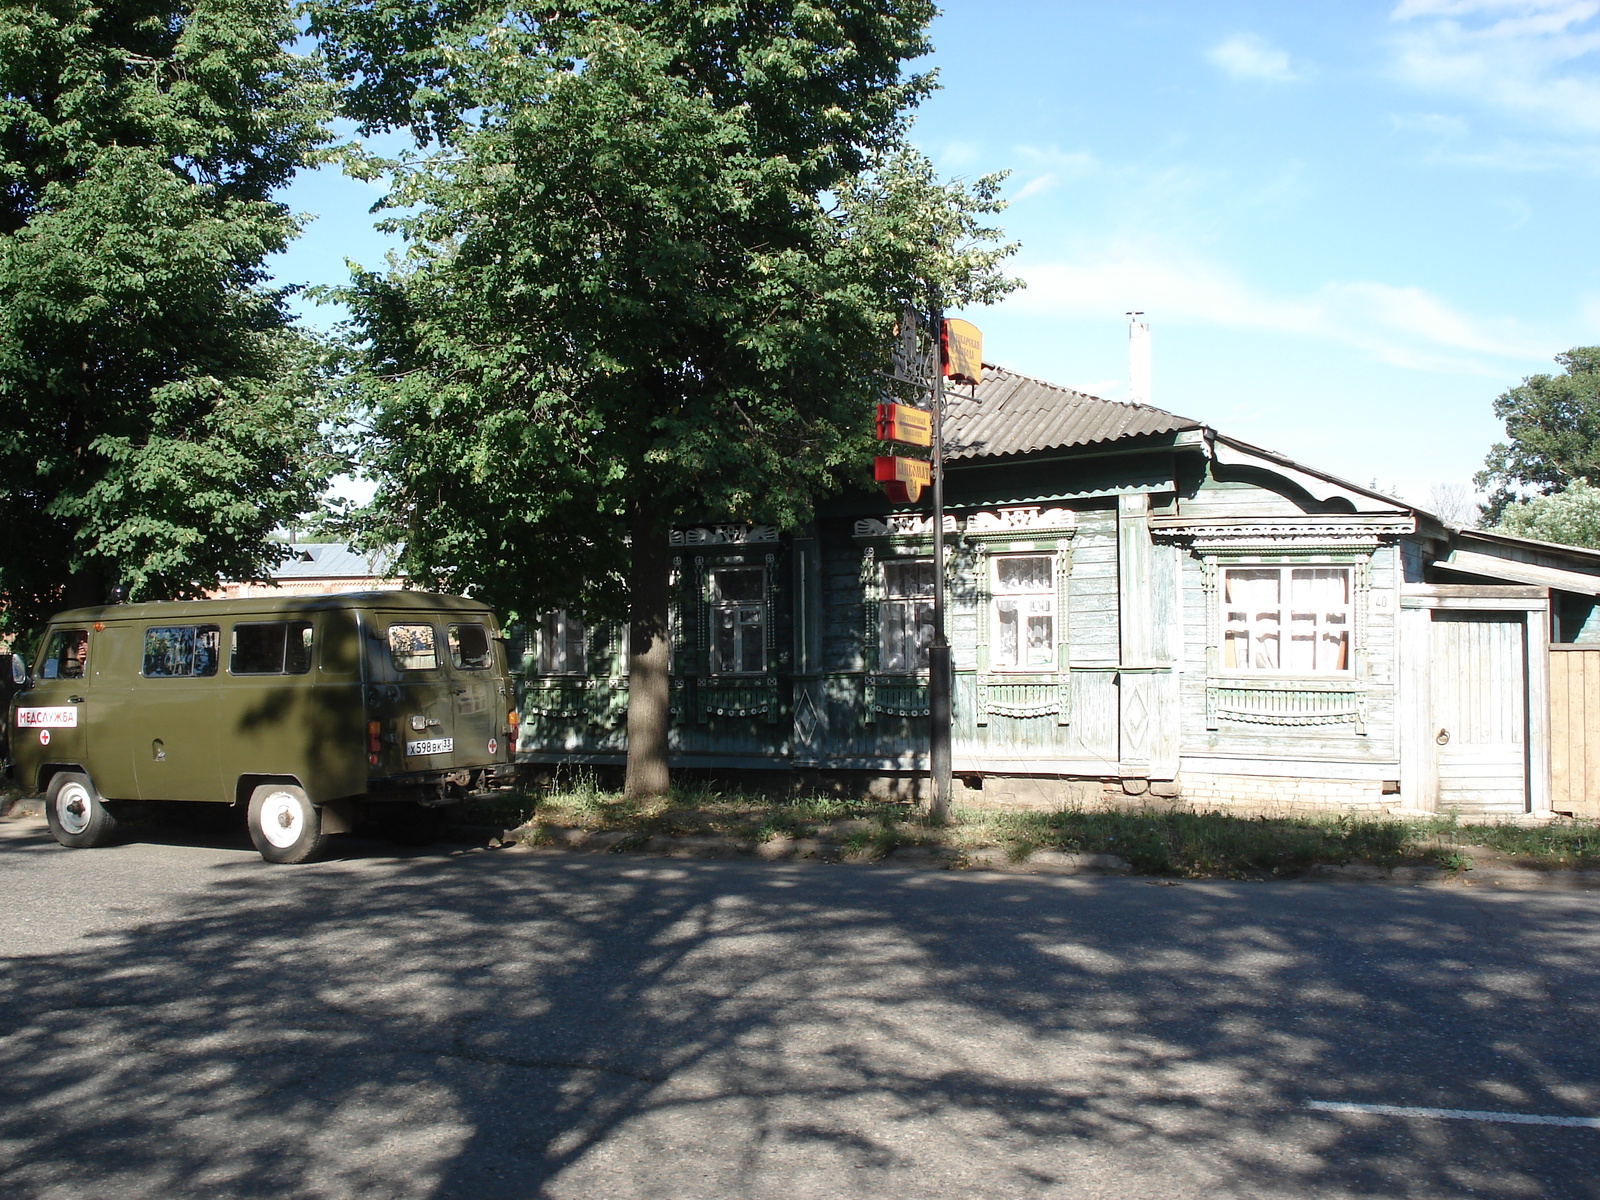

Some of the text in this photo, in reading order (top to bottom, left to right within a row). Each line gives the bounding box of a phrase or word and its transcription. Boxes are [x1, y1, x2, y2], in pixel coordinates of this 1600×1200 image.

[896, 462, 929, 482] БАНКОМАТ
[910, 478, 917, 492] 24
[19, 711, 74, 725] МЕДСЛУЖБА
[410, 741, 442, 754] Х598ВК
[443, 739, 451, 748] 33
